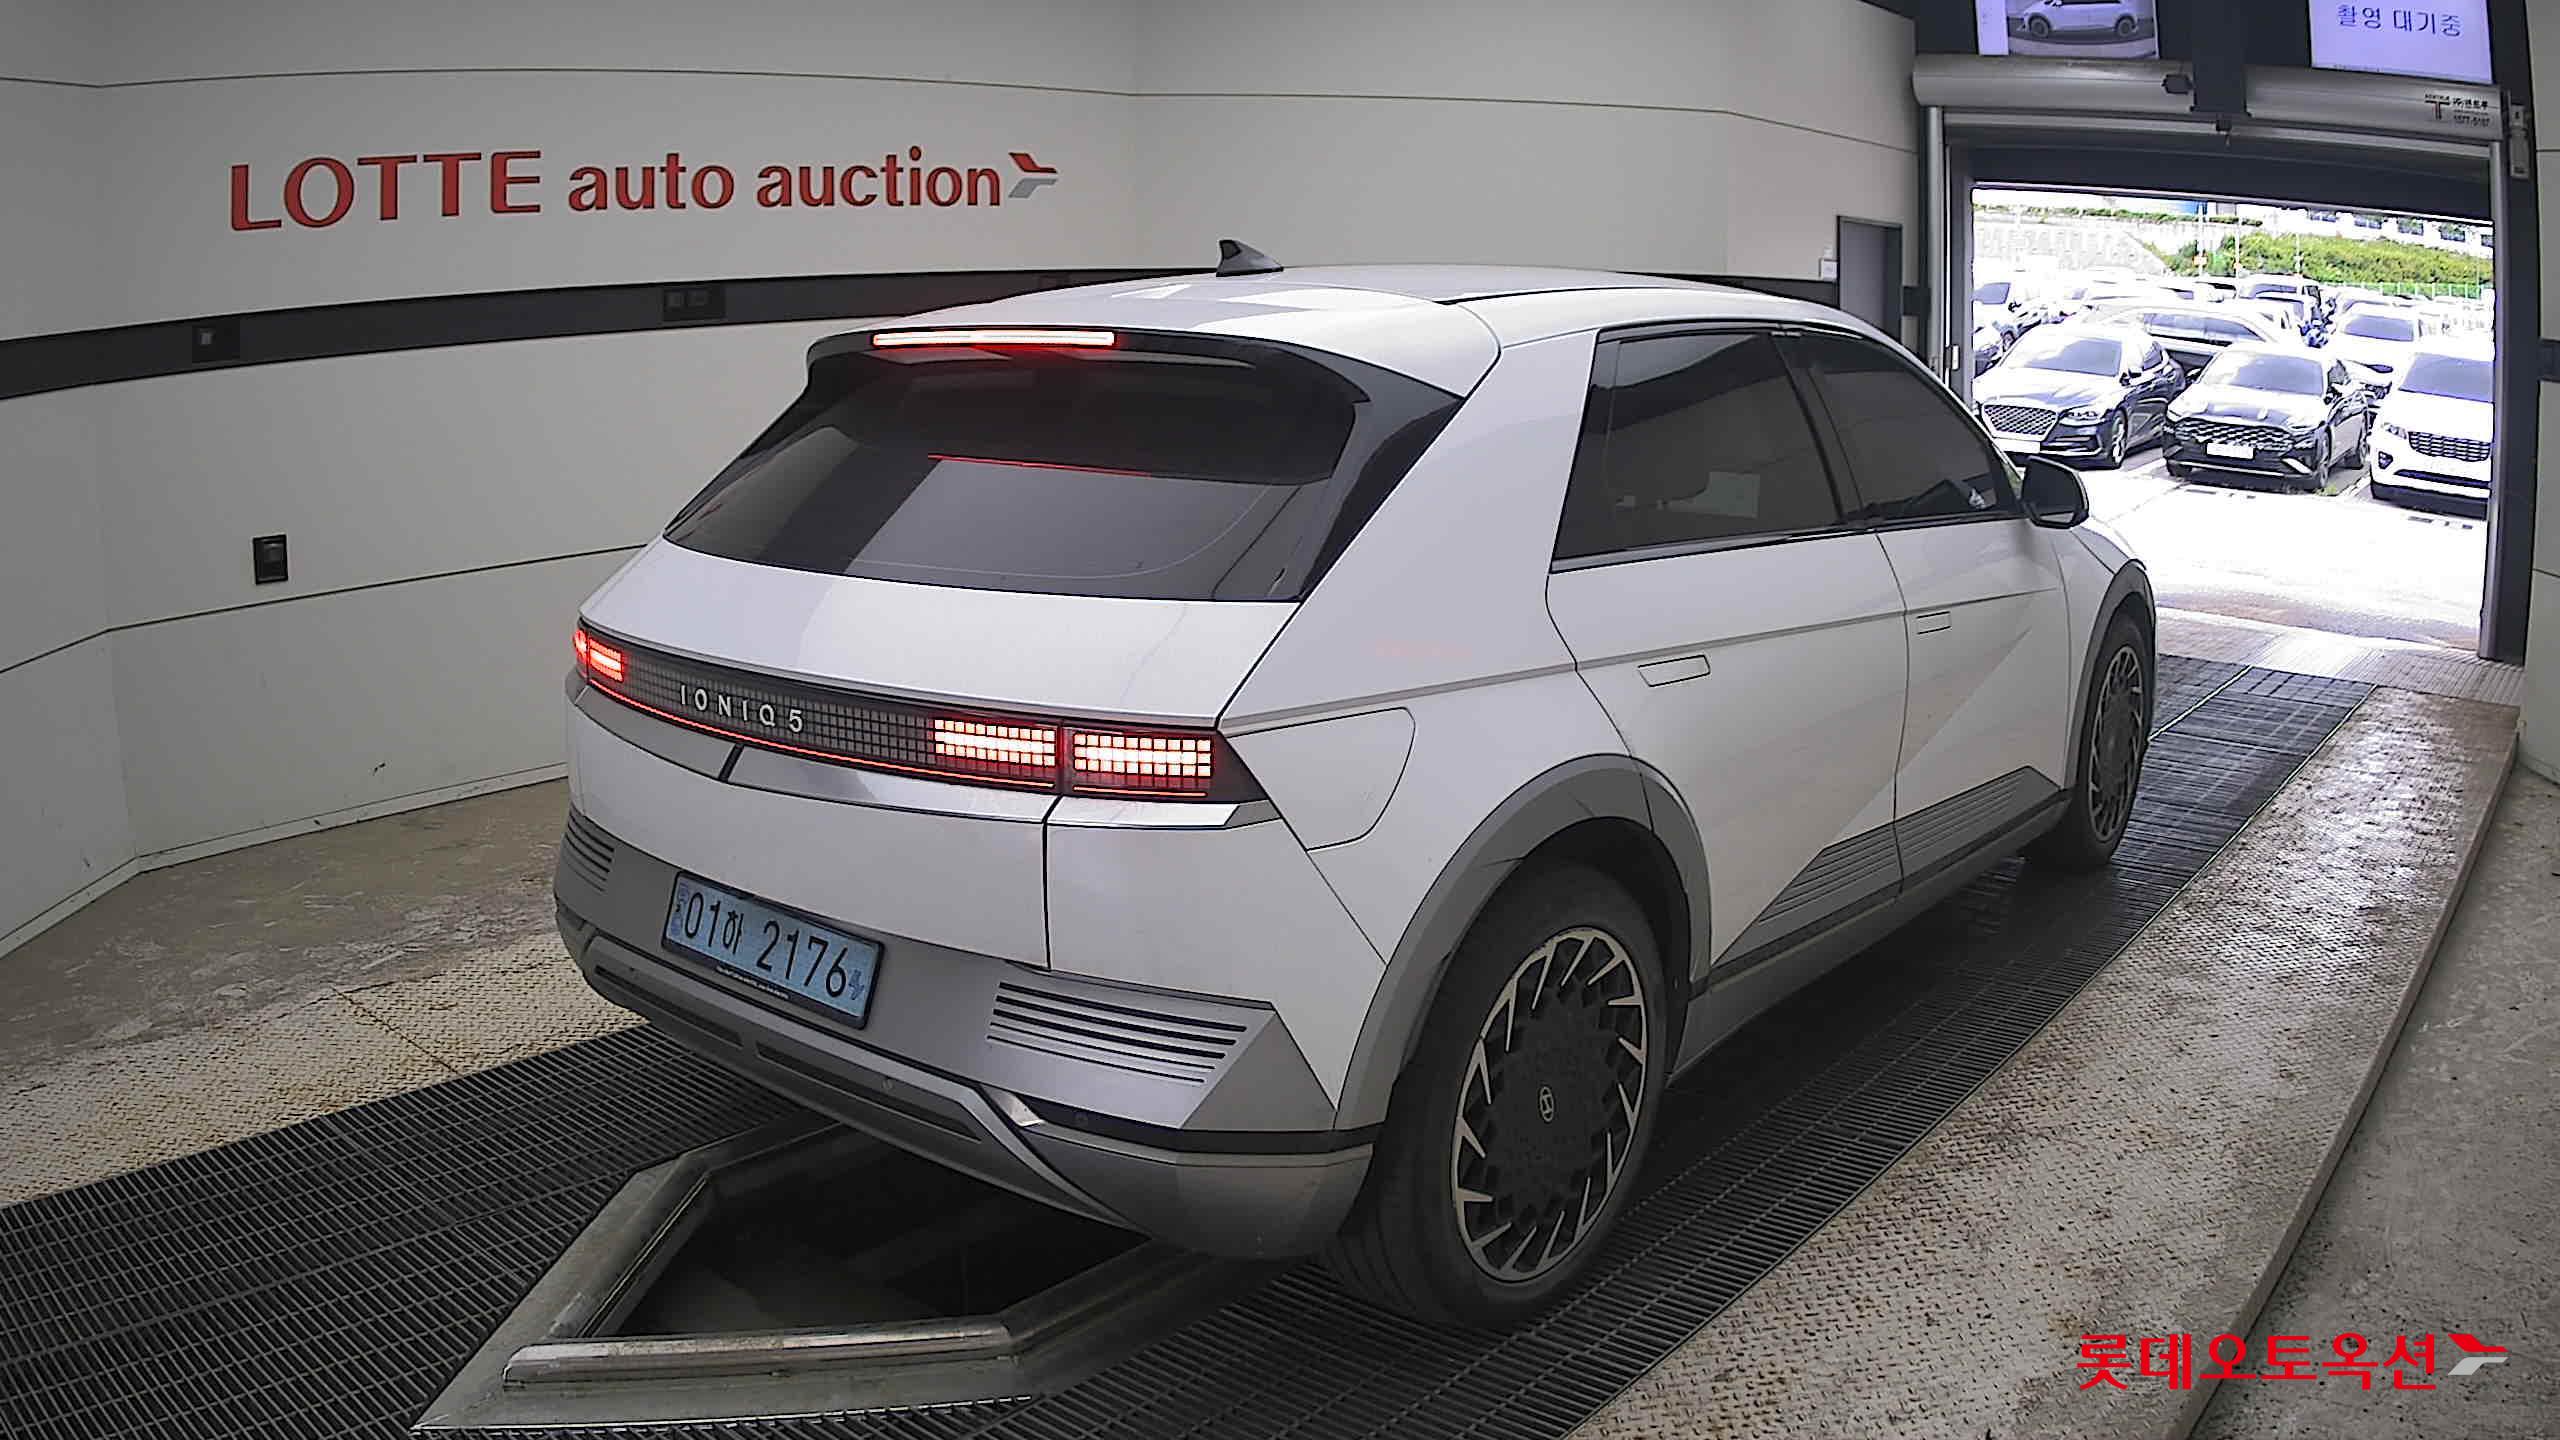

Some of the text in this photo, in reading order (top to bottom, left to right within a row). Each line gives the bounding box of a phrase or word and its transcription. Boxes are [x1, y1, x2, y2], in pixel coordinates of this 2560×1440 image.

[2338, 4, 2461, 37] 촬영 대기중
[231, 146, 1002, 232] LOTTE auto auction
[681, 684, 803, 733] IONIQ 5
[684, 891, 745, 955] 01하
[755, 919, 848, 998] 2176
